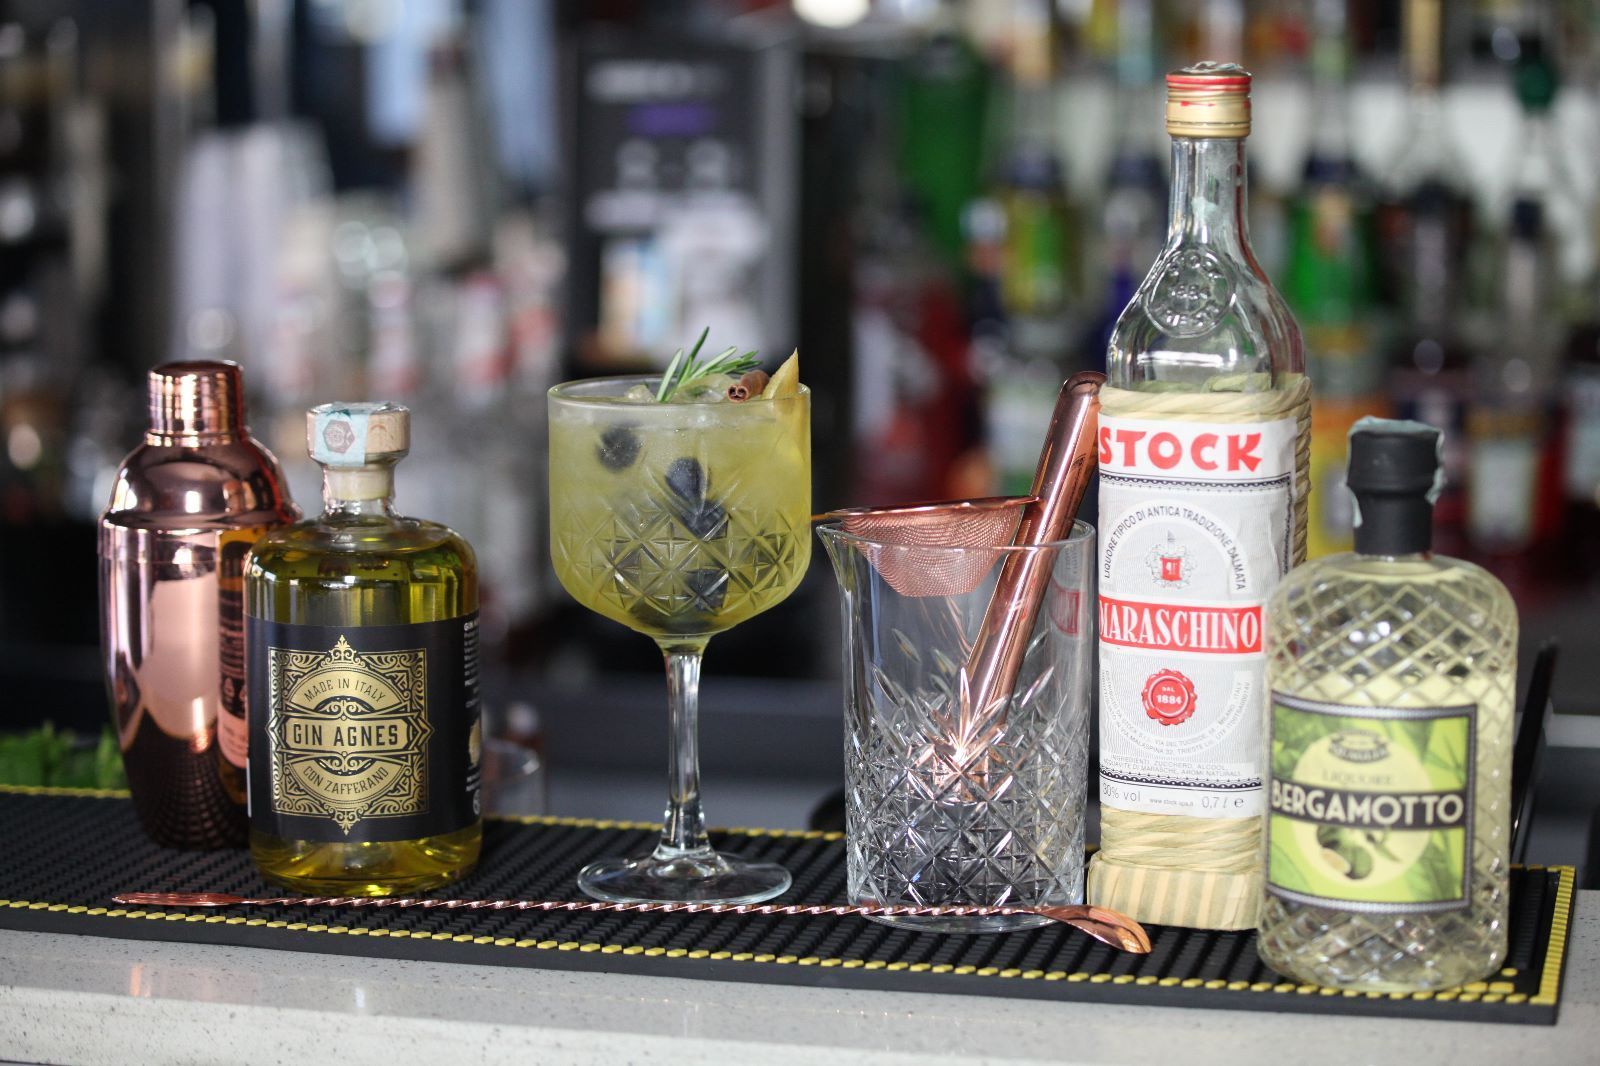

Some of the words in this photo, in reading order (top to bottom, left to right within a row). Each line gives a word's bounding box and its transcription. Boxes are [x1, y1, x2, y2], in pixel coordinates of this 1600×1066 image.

[1099, 426, 1263, 472] STOCK
[1104, 537, 1118, 579] LIQUORE
[1113, 515, 1138, 538] TIPICO
[1135, 510, 1147, 522] DI
[1147, 505, 1181, 518] ANTICA
[1182, 508, 1234, 548] TRADIZIONE
[1227, 546, 1247, 591] DALMATA
[1099, 601, 1259, 650] MARASCHINO
[303, 678, 334, 702] MADE
[338, 678, 350, 689] IN
[355, 679, 387, 703] ITALY
[1156, 694, 1183, 705] 1884
[293, 723, 322, 746] GIN
[333, 724, 399, 747] AGNES
[302, 765, 324, 786] CON
[324, 766, 390, 795] ZAFFERANO
[1102, 783, 1119, 799] 30%
[1123, 788, 1141, 803] vol
[1272, 779, 1464, 825] BERGAMOTTO
